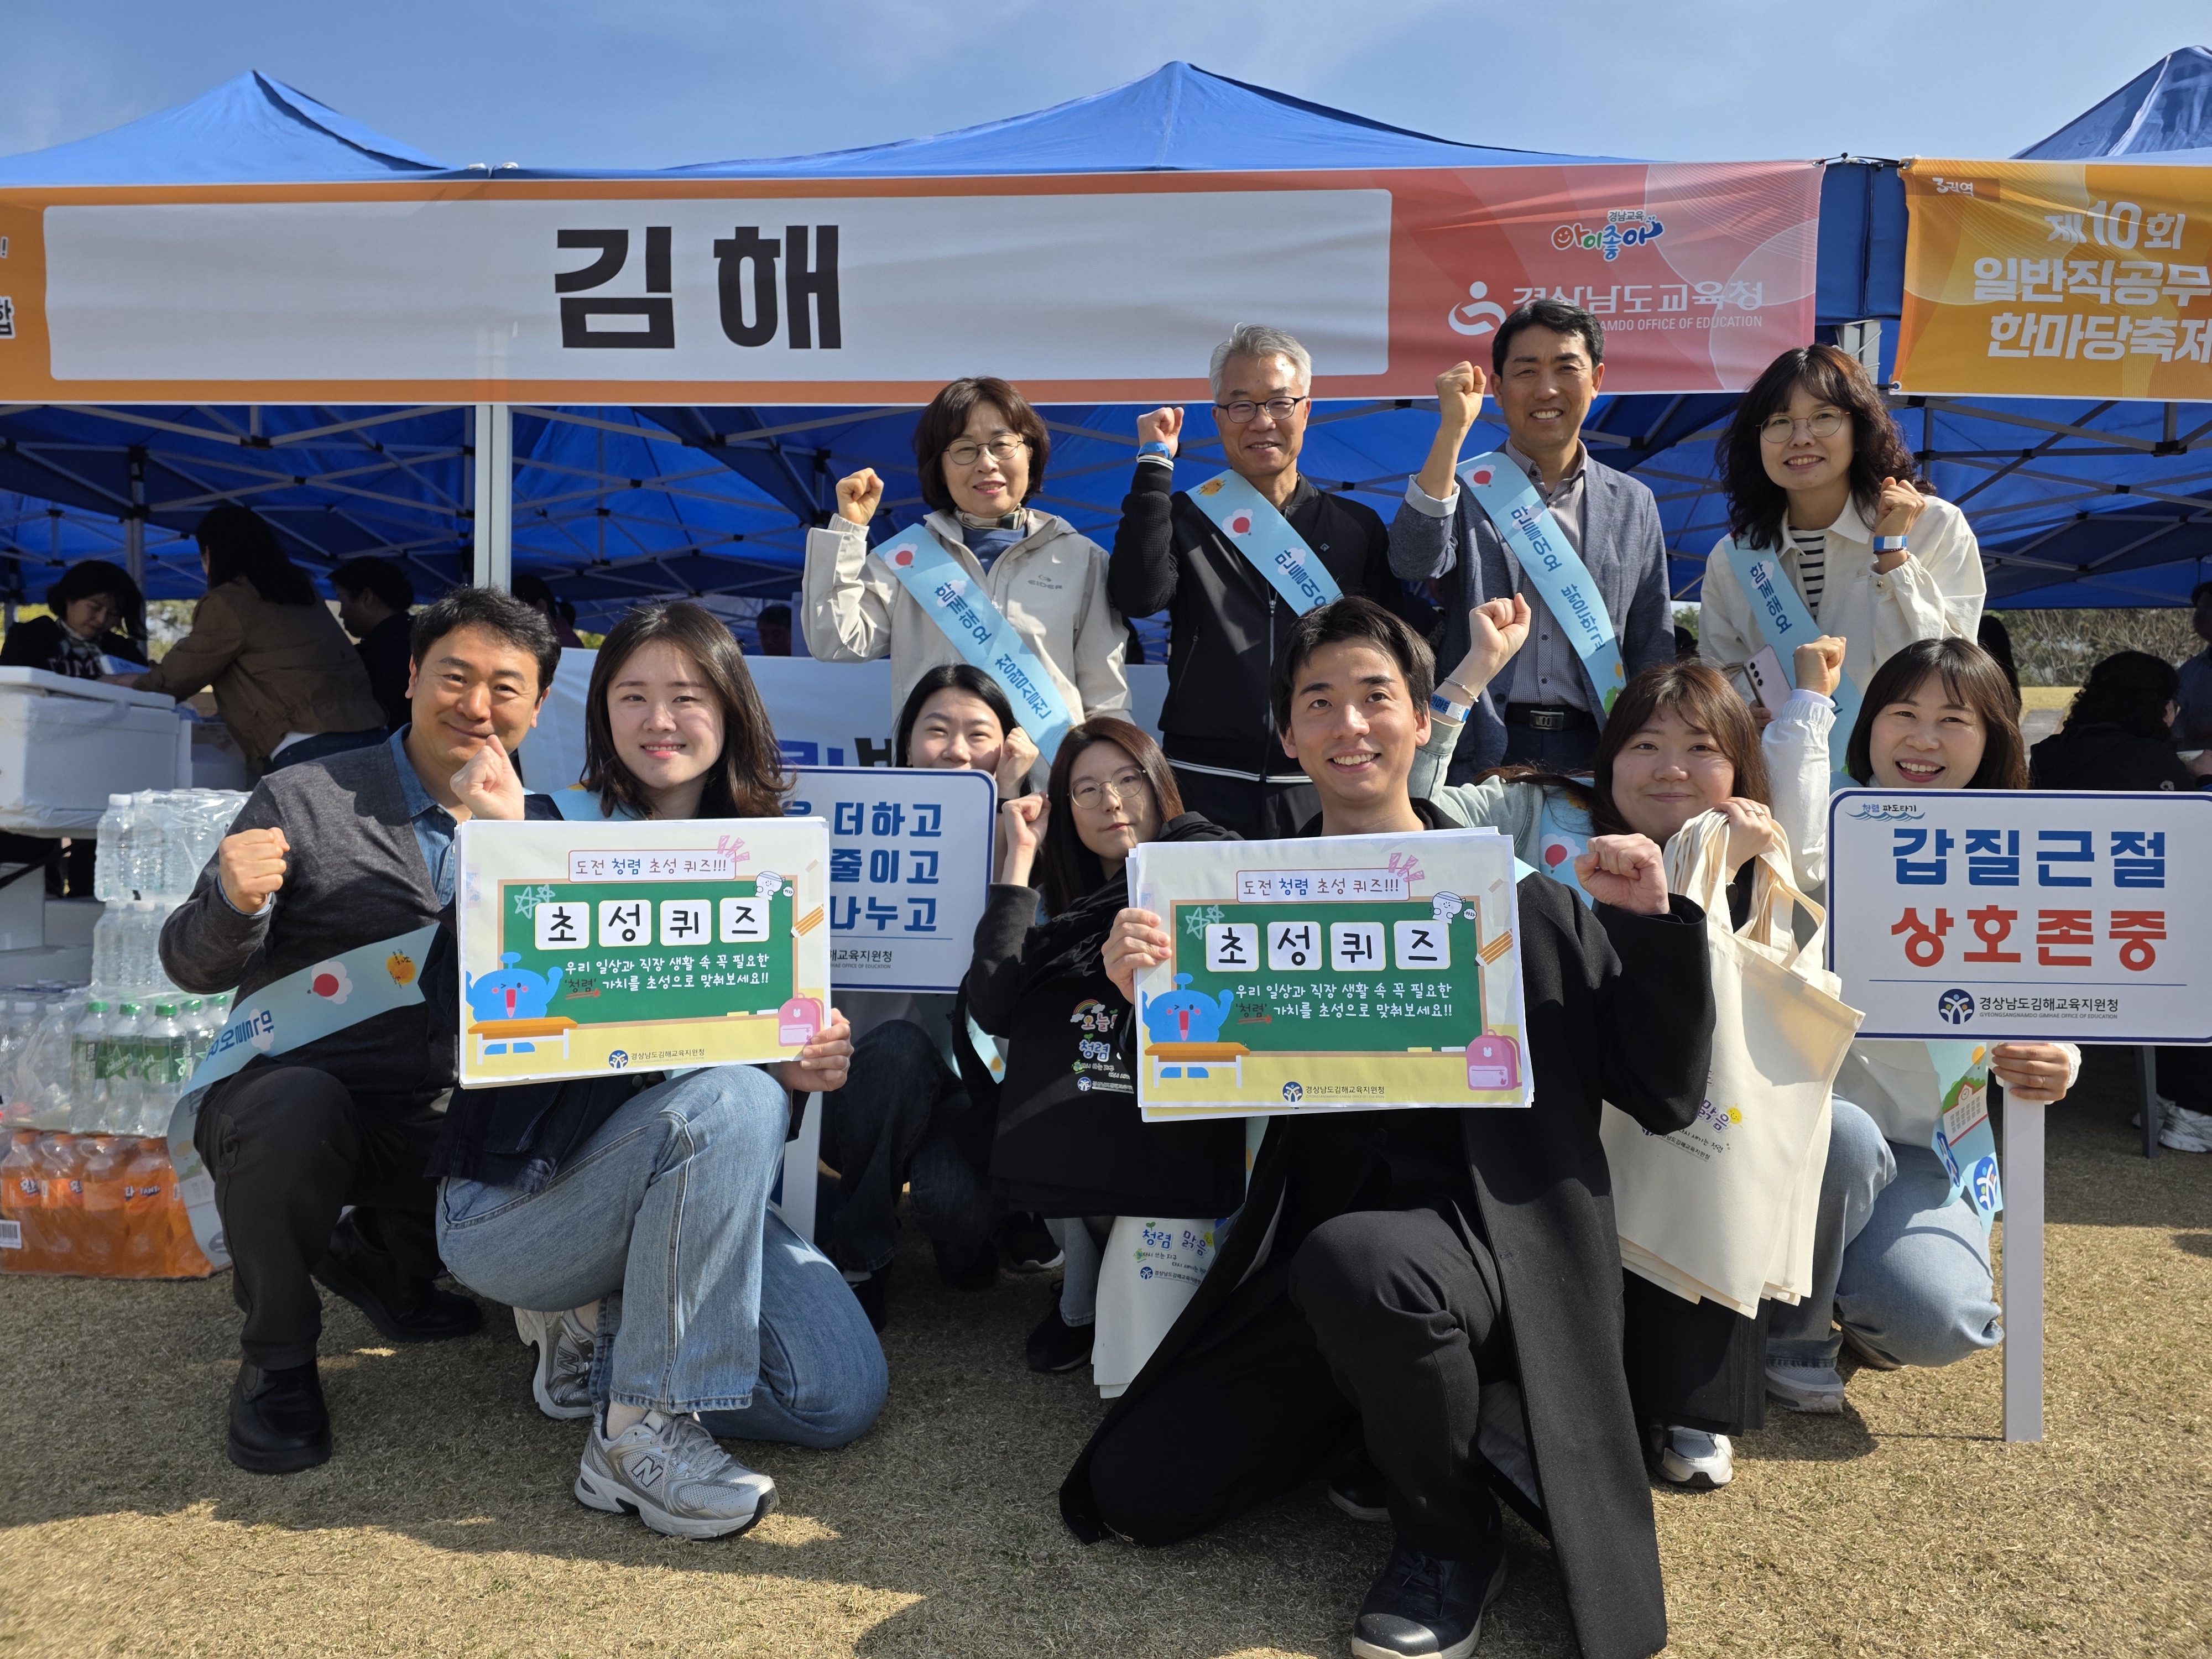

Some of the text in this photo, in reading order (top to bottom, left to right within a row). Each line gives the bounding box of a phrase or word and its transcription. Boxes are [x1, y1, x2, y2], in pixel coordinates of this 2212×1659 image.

[1609, 211, 1645, 222] 경남교육
[2045, 201, 2185, 249] 제10회
[1553, 222, 1663, 260] 아이좋아
[555, 225, 841, 349] 김해
[1974, 257, 2212, 306] 일반직공무
[1637, 318, 1674, 331] OFFICE
[1678, 317, 1694, 329] OF
[1696, 315, 1762, 328] EDUCATION
[1987, 312, 2212, 363] 한마당축제
[1511, 505, 1606, 651] 만들어요 밝은학교
[1750, 562, 1792, 634] 함께해요
[935, 582, 1051, 720] 함께해요 청렴실천
[833, 801, 941, 837] 더하고
[1862, 804, 1880, 813] 청렴
[576, 858, 727, 875] 도전 청렴 초성 퀴즈!!!
[830, 848, 940, 884] 줄이고
[1893, 828, 2166, 888] 갑질근절
[1243, 878, 1399, 896] 도전 청렴 초성 퀴즈!!!
[830, 896, 937, 932] 나누고
[1891, 905, 2167, 972] 상호존중
[565, 953, 769, 975] 우리 일상과 직장 생활 속 꼭 필요한
[602, 975, 640, 992] 가치를
[646, 974, 695, 990] 초성으로
[701, 972, 769, 988] 맞춰보세요!!
[1235, 982, 1452, 999] 우리 일상과 직장 생활 속 꼭 필요한
[1273, 1002, 1312, 1019] 가치를
[1319, 1003, 1370, 1018] 초성으로
[1376, 1003, 1452, 1019] 맞춰보세요!!
[1980, 997, 2119, 1012] 경상남도김해교육지원청
[206, 1010, 274, 1062] 만들어요
[1080, 1041, 1109, 1060] 청렴
[631, 1048, 705, 1060] 경상남도김해교육지원청
[1306, 1086, 1385, 1094] 경상남도김해교육지원청
[1698, 1099, 1729, 1131] 맑음
[1142, 1229, 1206, 1256] 청렴 맑음
[632, 1455, 663, 1488] N
